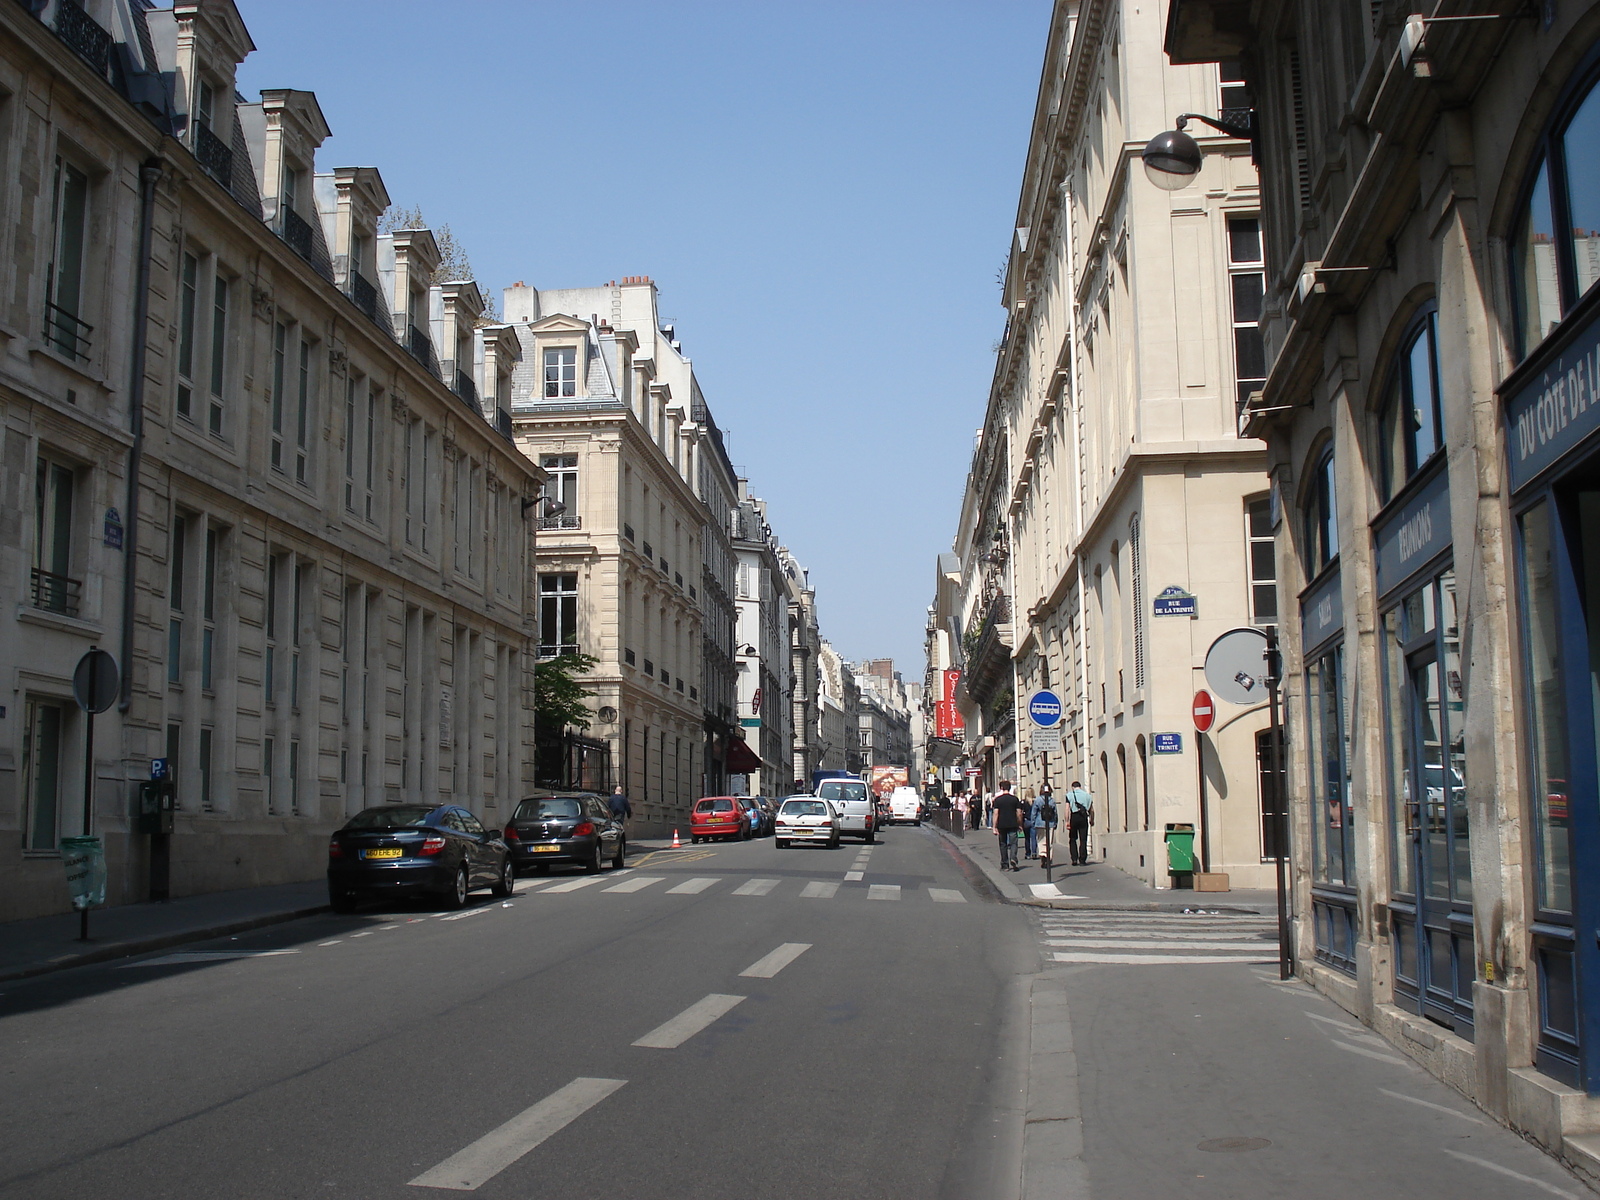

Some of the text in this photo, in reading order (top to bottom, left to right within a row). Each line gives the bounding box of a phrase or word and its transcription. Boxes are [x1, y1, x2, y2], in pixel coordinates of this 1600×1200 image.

[1518, 404, 1535, 461] DU
[1537, 358, 1567, 446] CÔTÉ
[1568, 359, 1586, 421] DE
[1398, 502, 1432, 563] RÉUNIONS
[1173, 605, 1194, 613] TRINITÉ
[152, 760, 162, 774] P
[392, 848, 401, 856] 92
